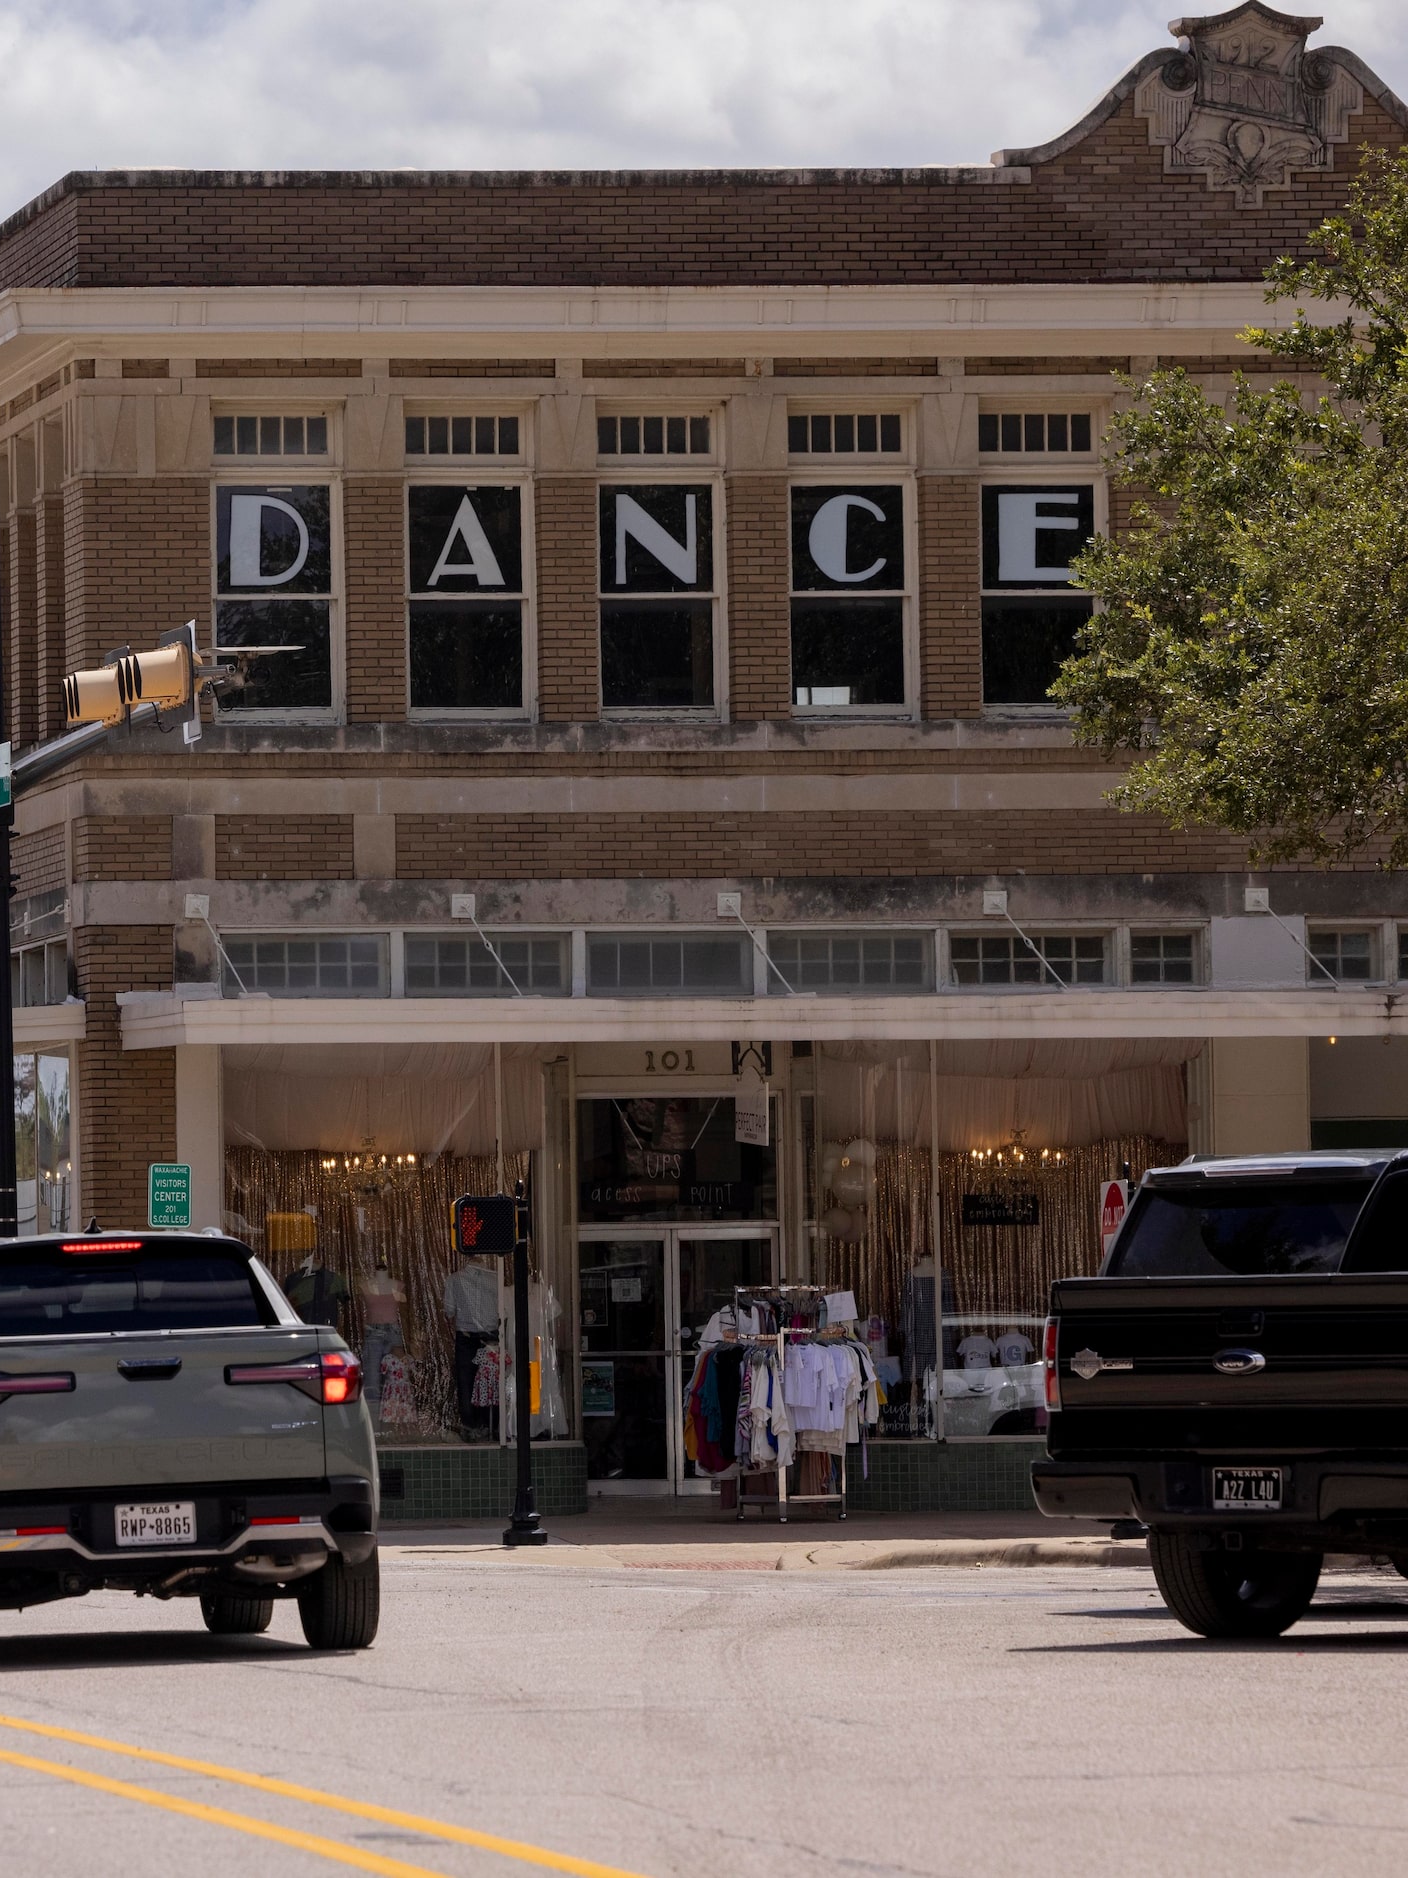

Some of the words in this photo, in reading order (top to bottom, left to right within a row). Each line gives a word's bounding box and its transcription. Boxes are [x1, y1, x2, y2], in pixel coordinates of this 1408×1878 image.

[1217, 32, 1278, 73] 1912
[1210, 69, 1290, 115] PENN
[229, 493, 1079, 586] DANCE
[645, 1050, 695, 1073] 101
[646, 1153, 681, 1179] UPS
[155, 1179, 187, 1188] VISITORS
[154, 1191, 187, 1202] CENTER
[165, 1205, 176, 1213] 201
[1104, 1207, 1112, 1226] DO
[1232, 1470, 1264, 1478] TEXAS
[1222, 1480, 1245, 1500] A2Z
[1252, 1480, 1274, 1500] L4U
[140, 1506, 170, 1515] TEXAS
